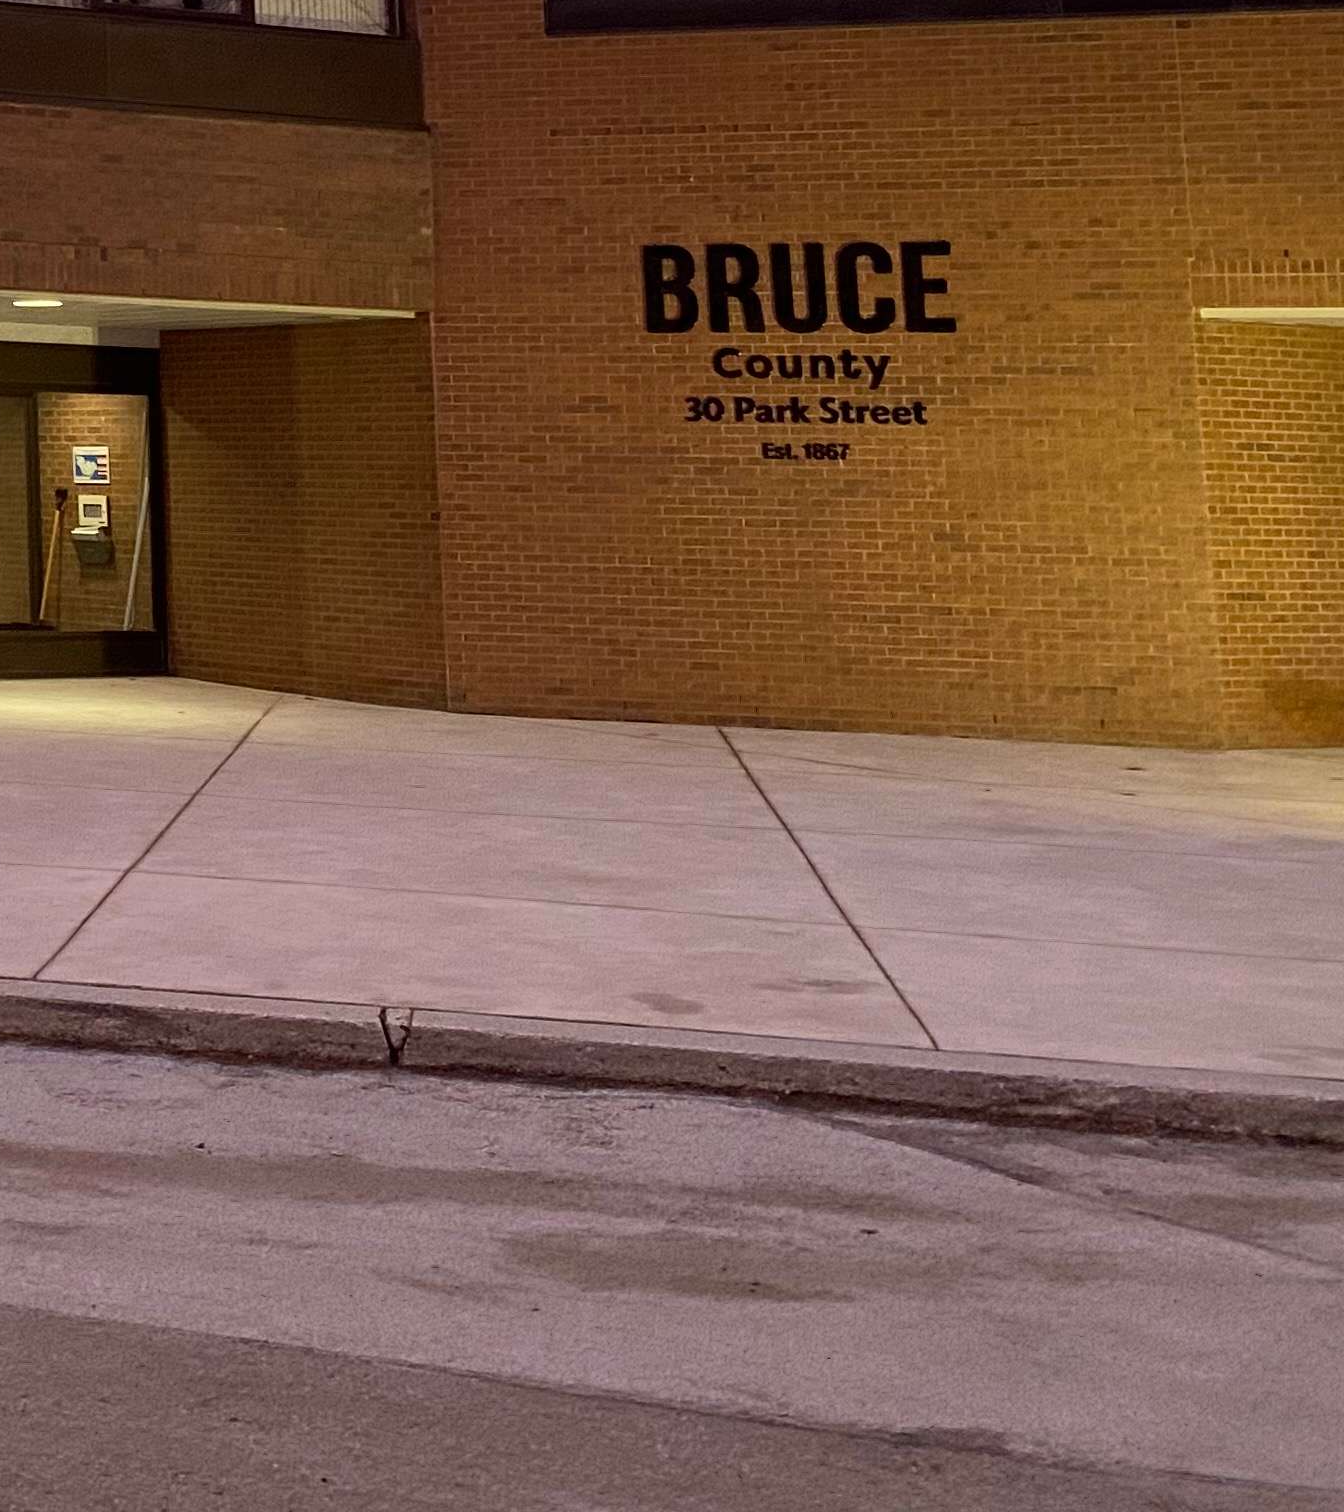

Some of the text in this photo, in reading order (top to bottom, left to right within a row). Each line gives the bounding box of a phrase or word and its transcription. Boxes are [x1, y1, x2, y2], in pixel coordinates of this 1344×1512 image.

[642, 240, 957, 333] BRUCE
[712, 347, 891, 390] County
[684, 396, 928, 425] 30 Park Street
[761, 442, 851, 461] Est. 1867
